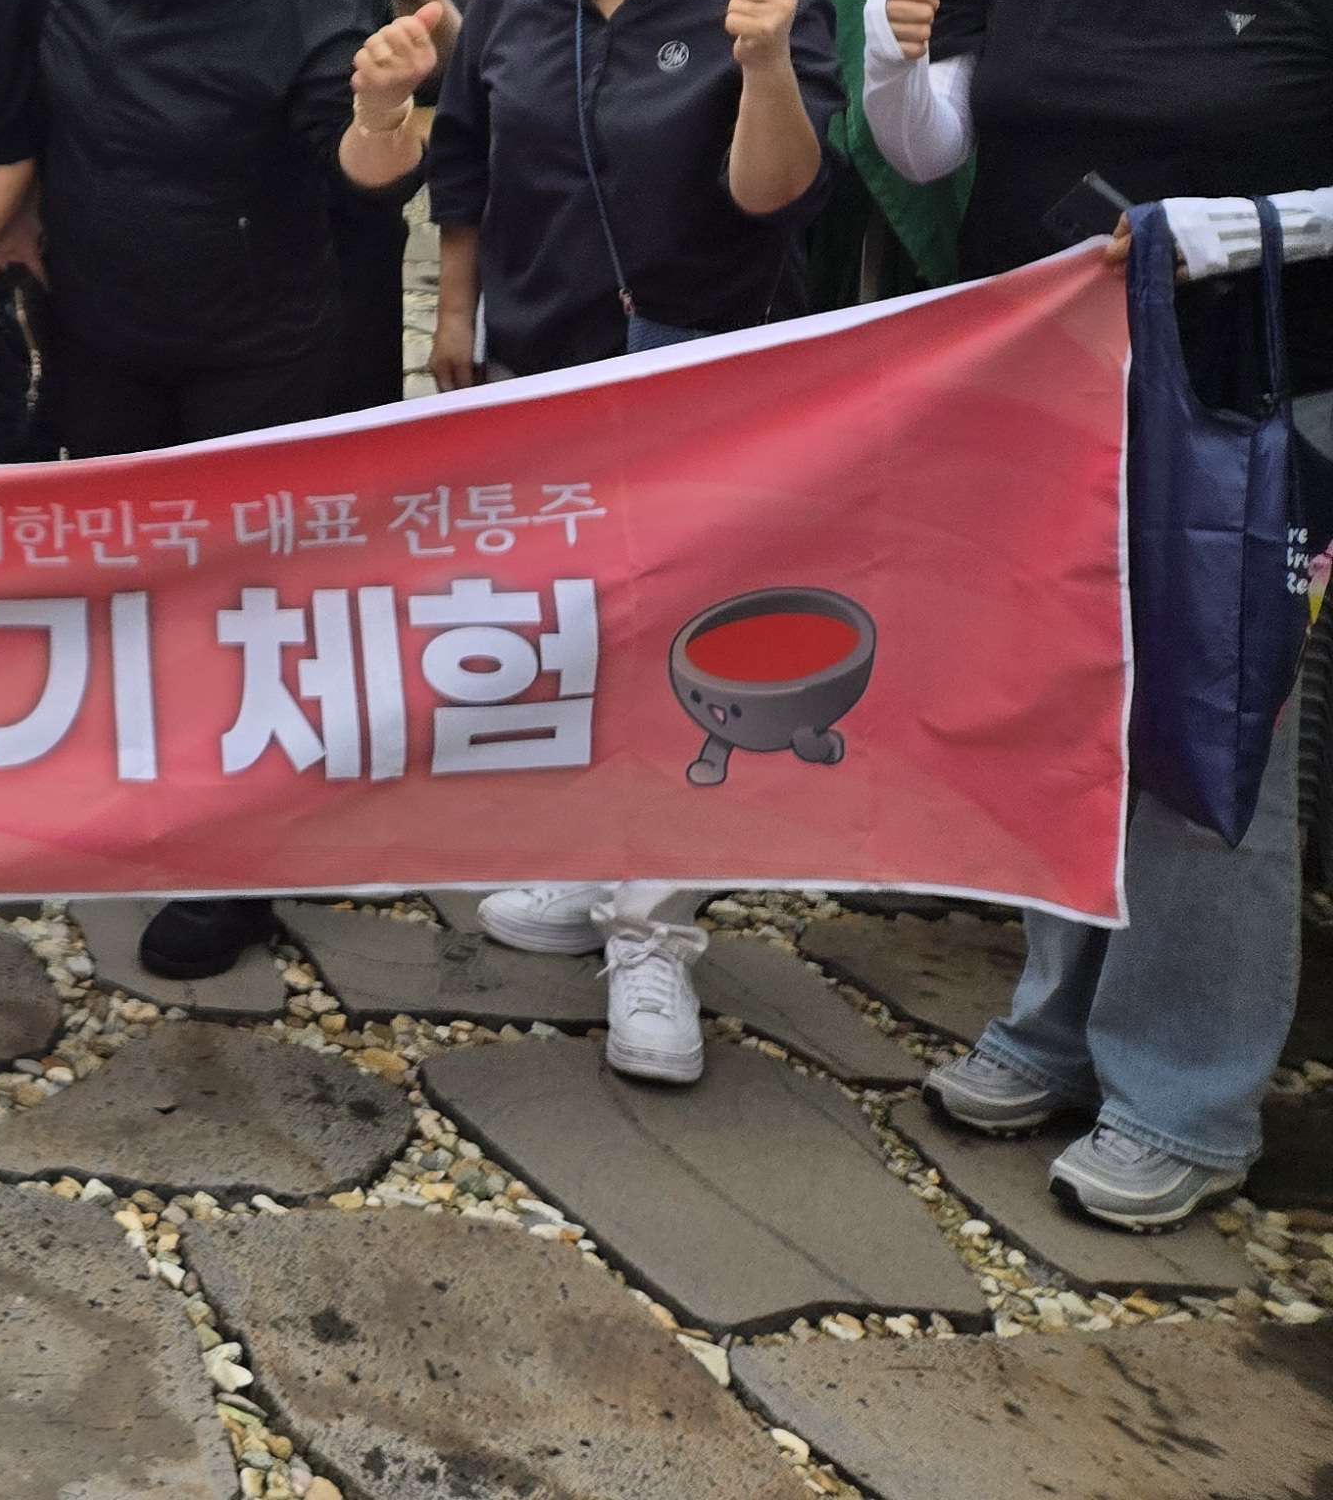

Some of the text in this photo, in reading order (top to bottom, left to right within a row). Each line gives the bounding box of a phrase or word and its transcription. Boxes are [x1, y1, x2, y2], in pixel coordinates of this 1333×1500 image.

[233, 491, 368, 558] 대표
[388, 480, 607, 558] 전통주
[215, 576, 601, 782] 체험
